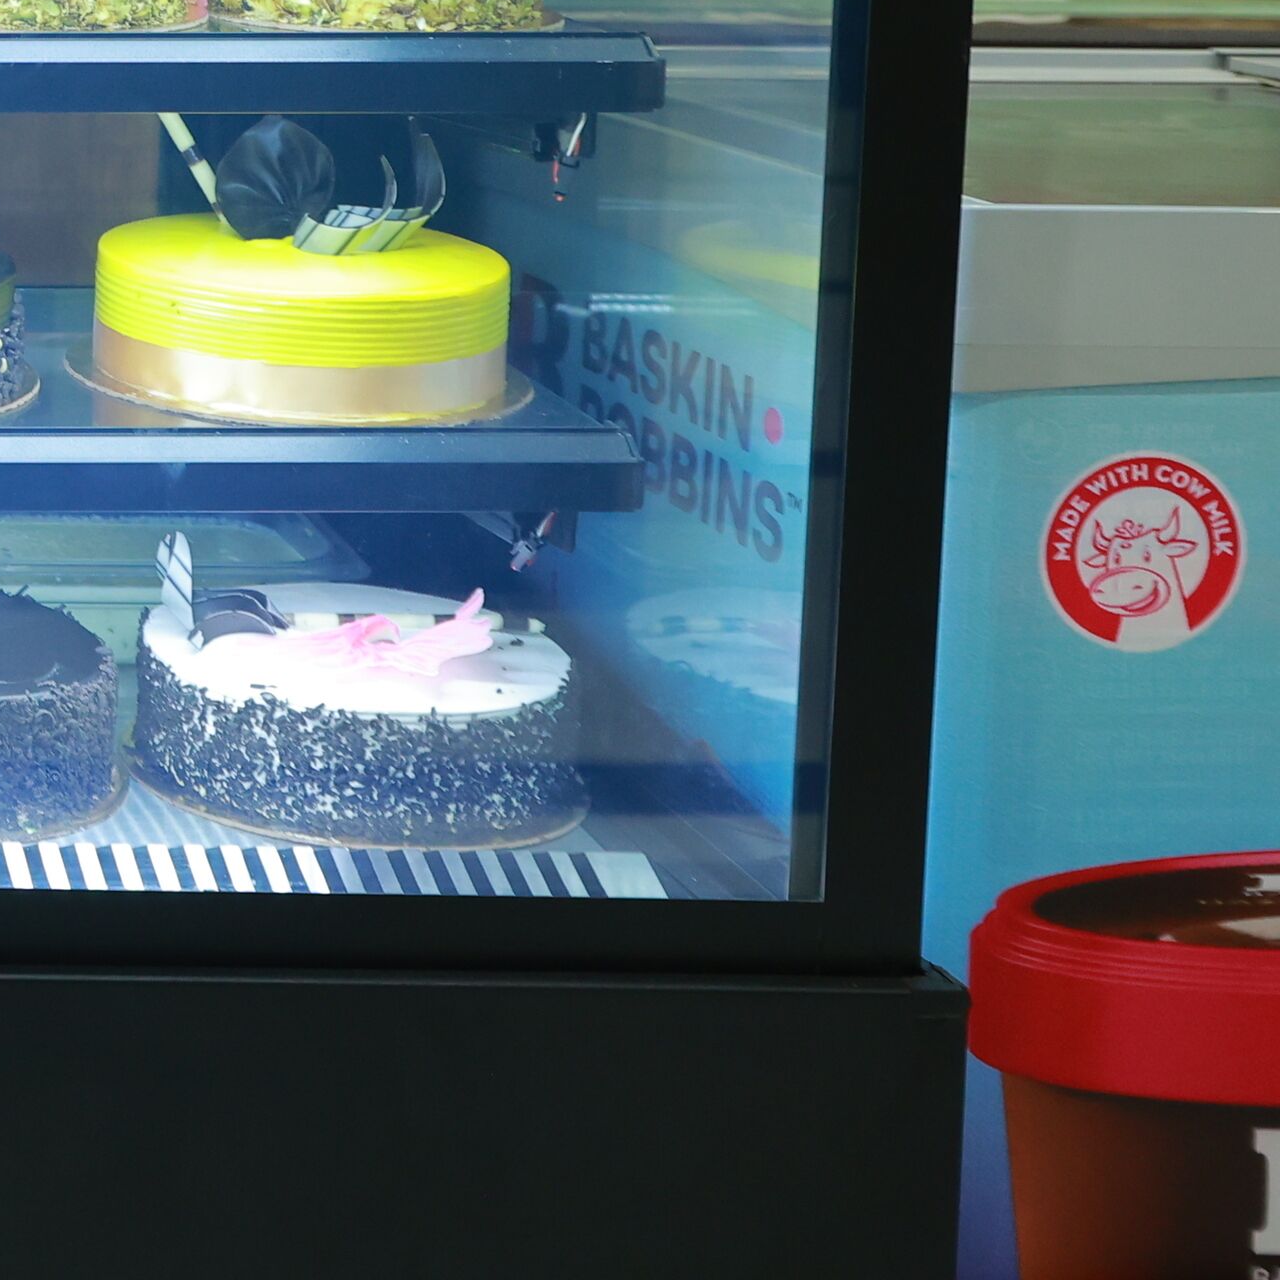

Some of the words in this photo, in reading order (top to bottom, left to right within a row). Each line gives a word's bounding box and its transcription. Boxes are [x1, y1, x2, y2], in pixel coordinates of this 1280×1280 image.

[583, 312, 754, 452] BASKIN
[1053, 495, 1090, 562] MADE
[1085, 463, 1149, 495] WITH
[1154, 465, 1211, 498] COW
[1203, 500, 1234, 557] MILK
